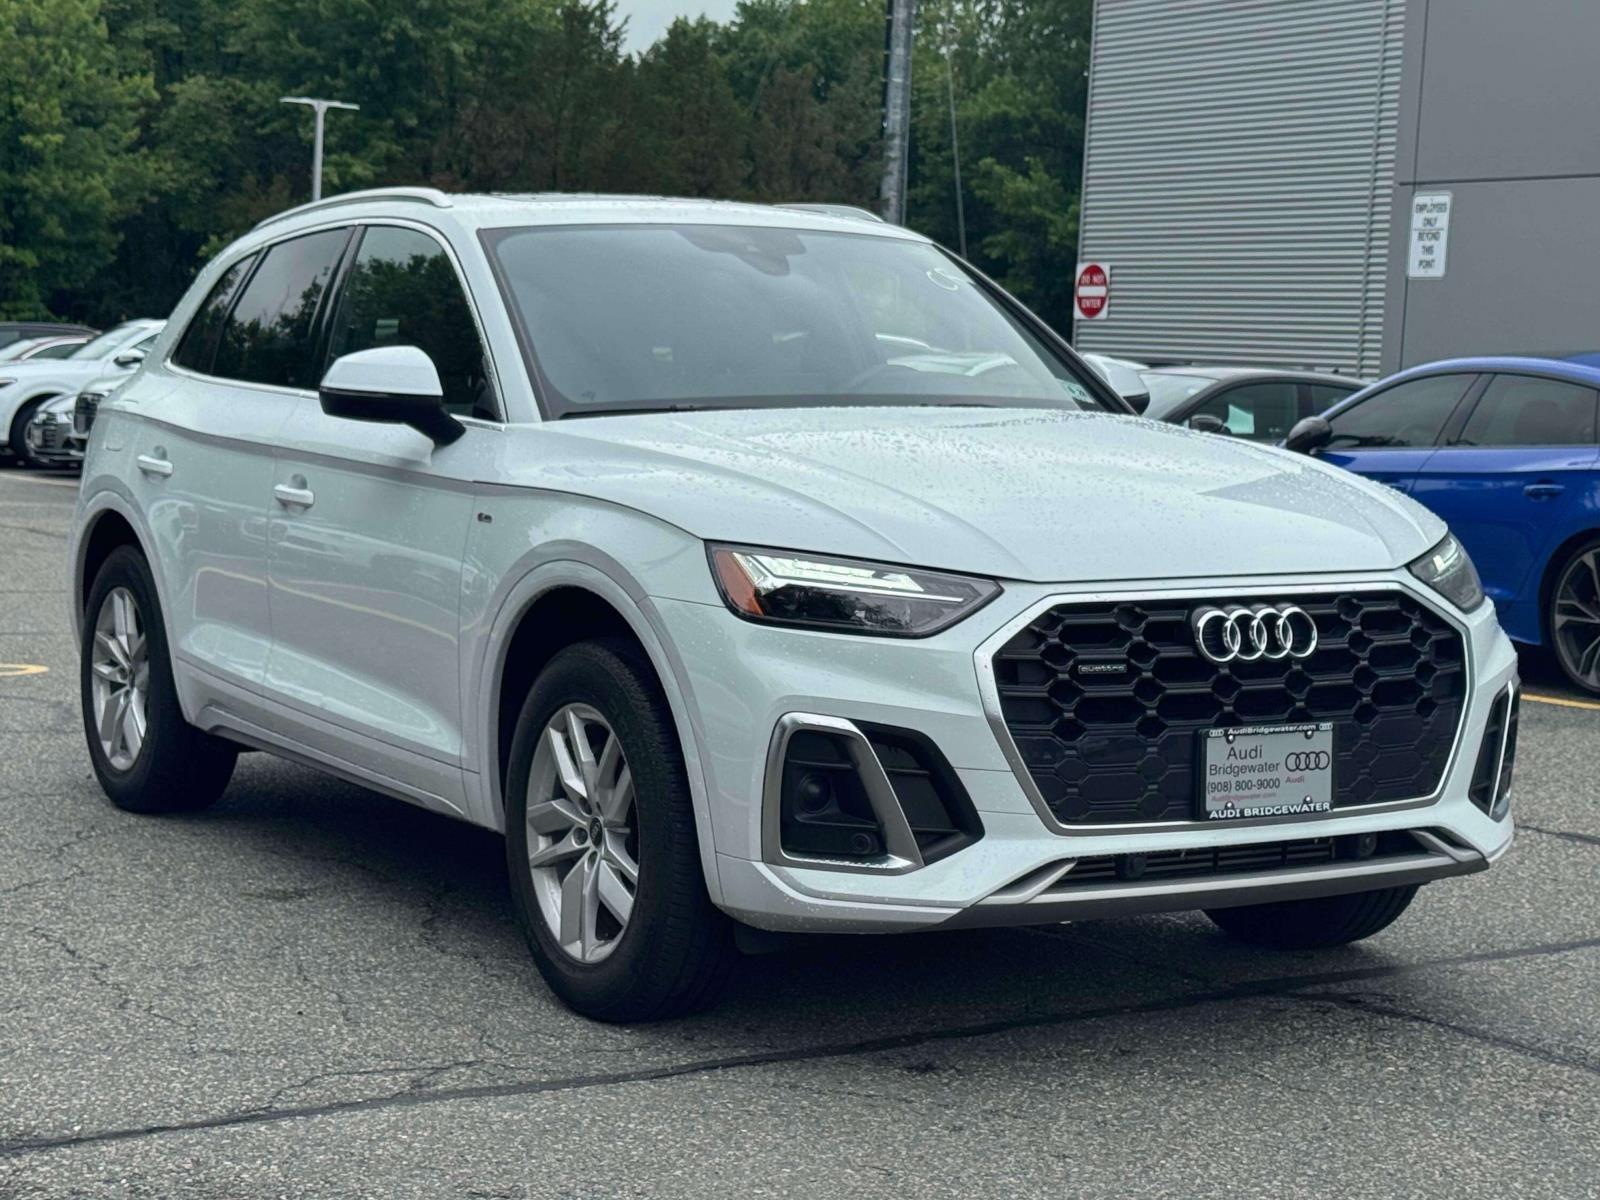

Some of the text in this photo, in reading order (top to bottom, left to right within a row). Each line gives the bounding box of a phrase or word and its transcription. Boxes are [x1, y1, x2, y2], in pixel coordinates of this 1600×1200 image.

[1423, 218, 1437, 227] ONLY
[1418, 231, 1441, 241] BEYOND
[1422, 245, 1434, 255] THIS
[1418, 259, 1435, 269] POINT
[1081, 274, 1104, 284] DO NOT
[1081, 298, 1101, 308] ENTER
[1227, 724, 1316, 735] AudiBridgewater.com
[1227, 745, 1263, 760] Audi
[1209, 762, 1280, 777] Bridgewater
[1285, 776, 1305, 784] Audi
[1207, 778, 1280, 794] (908) 800-9000
[1209, 802, 1330, 819] AUDI BRIDGEWATER
